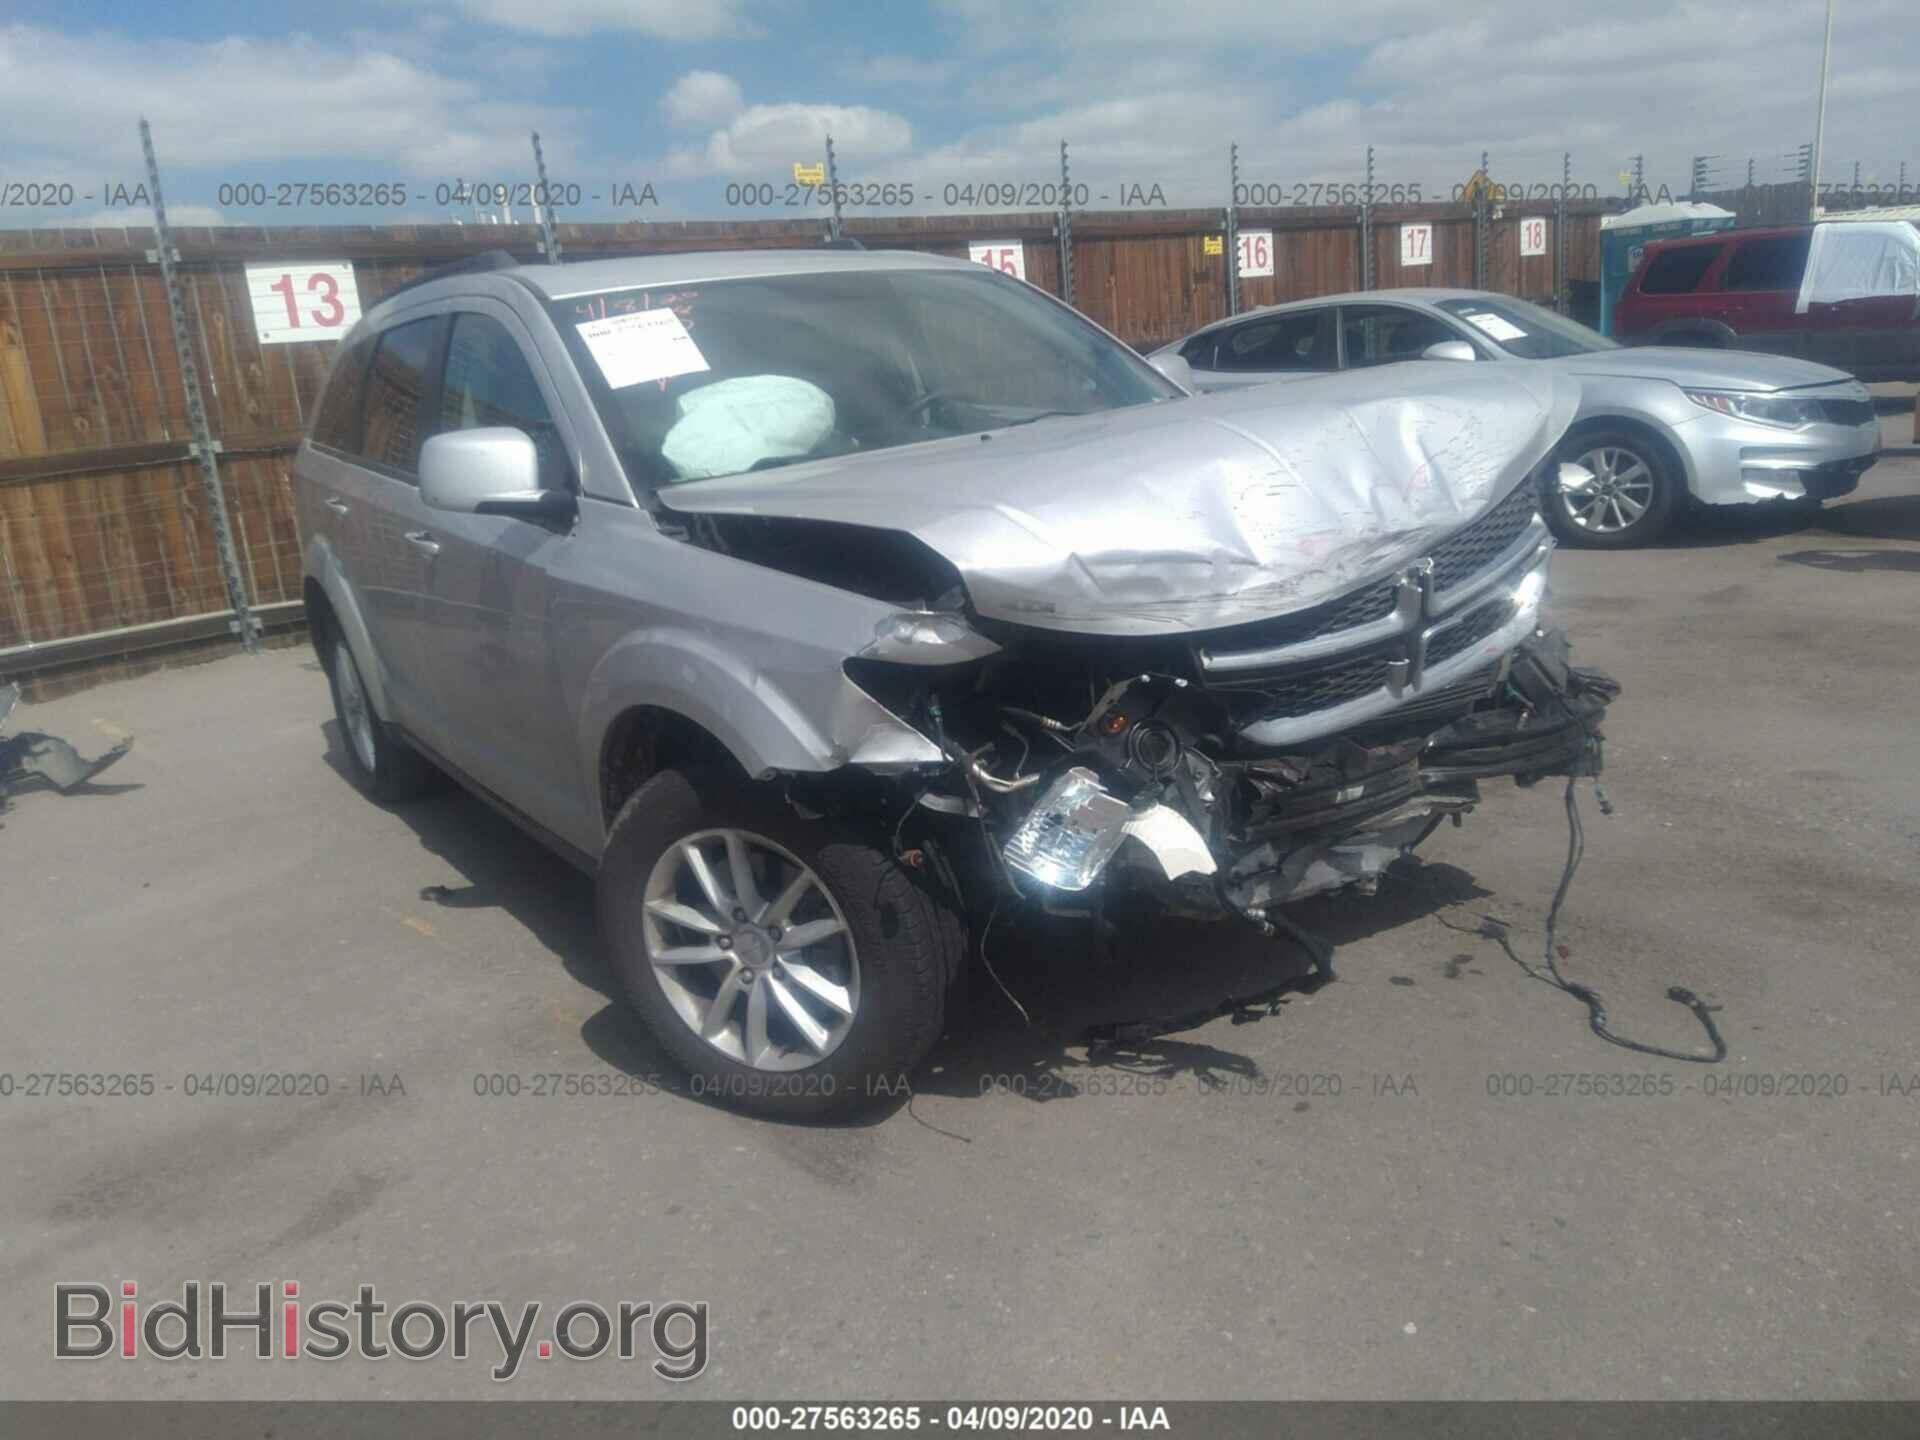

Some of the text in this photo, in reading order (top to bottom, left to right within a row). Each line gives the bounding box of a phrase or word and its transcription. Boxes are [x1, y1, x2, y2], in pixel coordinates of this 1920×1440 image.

[1407, 228, 1427, 257] 17
[1526, 222, 1542, 249] 18
[1242, 235, 1267, 269] 16
[271, 272, 344, 329] 13
